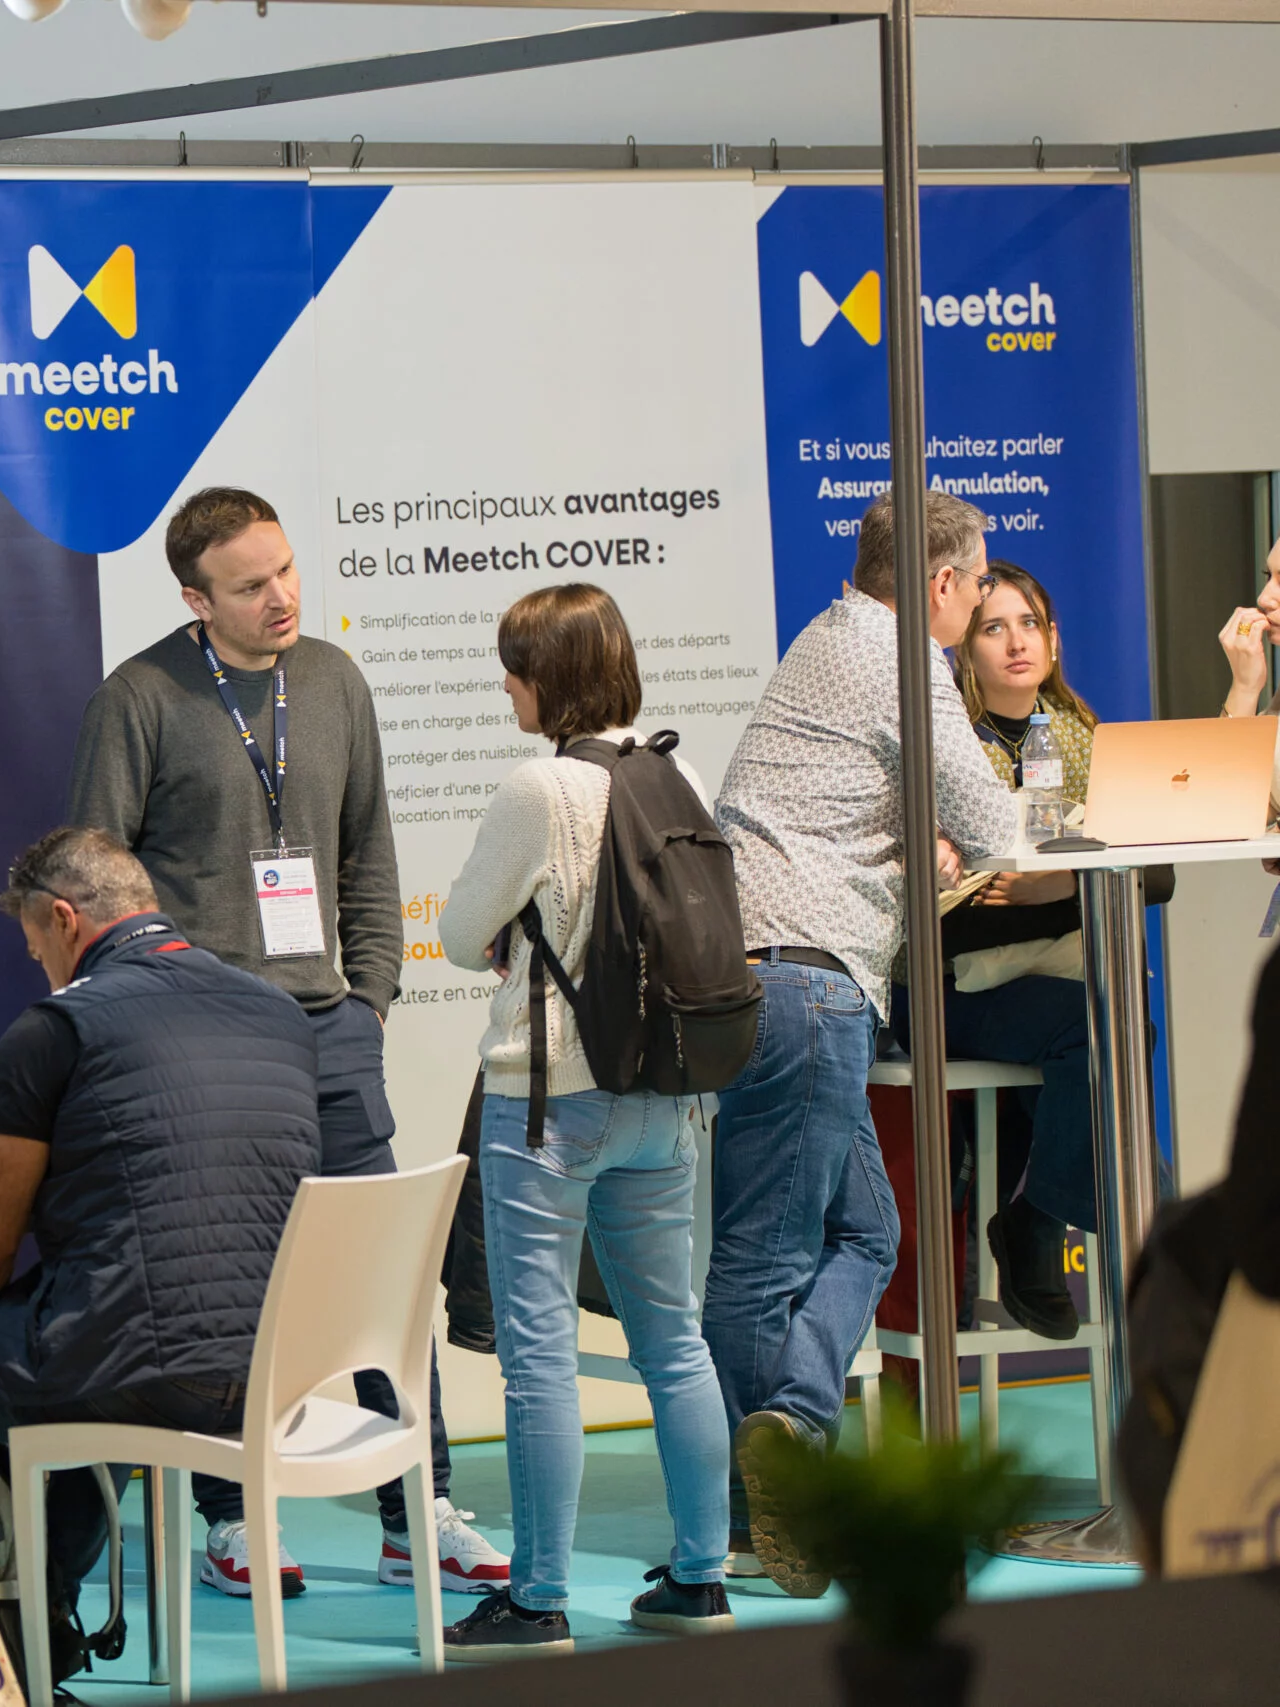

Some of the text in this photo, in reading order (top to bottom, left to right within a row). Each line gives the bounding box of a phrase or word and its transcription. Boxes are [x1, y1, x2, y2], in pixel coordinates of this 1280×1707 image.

[987, 332, 1056, 351] cover
[45, 407, 134, 430] cover
[800, 440, 821, 461] Et
[826, 438, 840, 460] si
[845, 443, 890, 459] vous
[1003, 433, 1063, 460] parler
[929, 471, 1048, 496] Annulation,
[337, 488, 720, 529] Les principaux avantages
[1001, 509, 1044, 531] voir.
[340, 549, 376, 577] de
[387, 548, 415, 575] la
[424, 542, 539, 573] Meetch
[546, 539, 650, 568] COVER
[360, 612, 456, 631] Simplification
[459, 611, 476, 624] de
[480, 611, 493, 623] la
[362, 649, 396, 663] Gain
[399, 648, 417, 661] de
[421, 649, 464, 662] temps
[467, 648, 485, 658] au
[635, 638, 648, 650] et
[651, 636, 674, 649] des
[678, 634, 730, 648] départs
[663, 669, 697, 682] états
[700, 667, 724, 680] des
[727, 665, 759, 678] lieux
[401, 720, 420, 730] en
[423, 715, 472, 730] charge
[476, 712, 500, 726] des
[679, 701, 755, 716] nettoyages
[388, 751, 448, 768] protéger
[452, 748, 476, 761] des
[480, 744, 537, 760] nuisibles
[444, 783, 481, 796] d'une
[393, 811, 450, 823] location
[444, 988, 466, 1001] en
